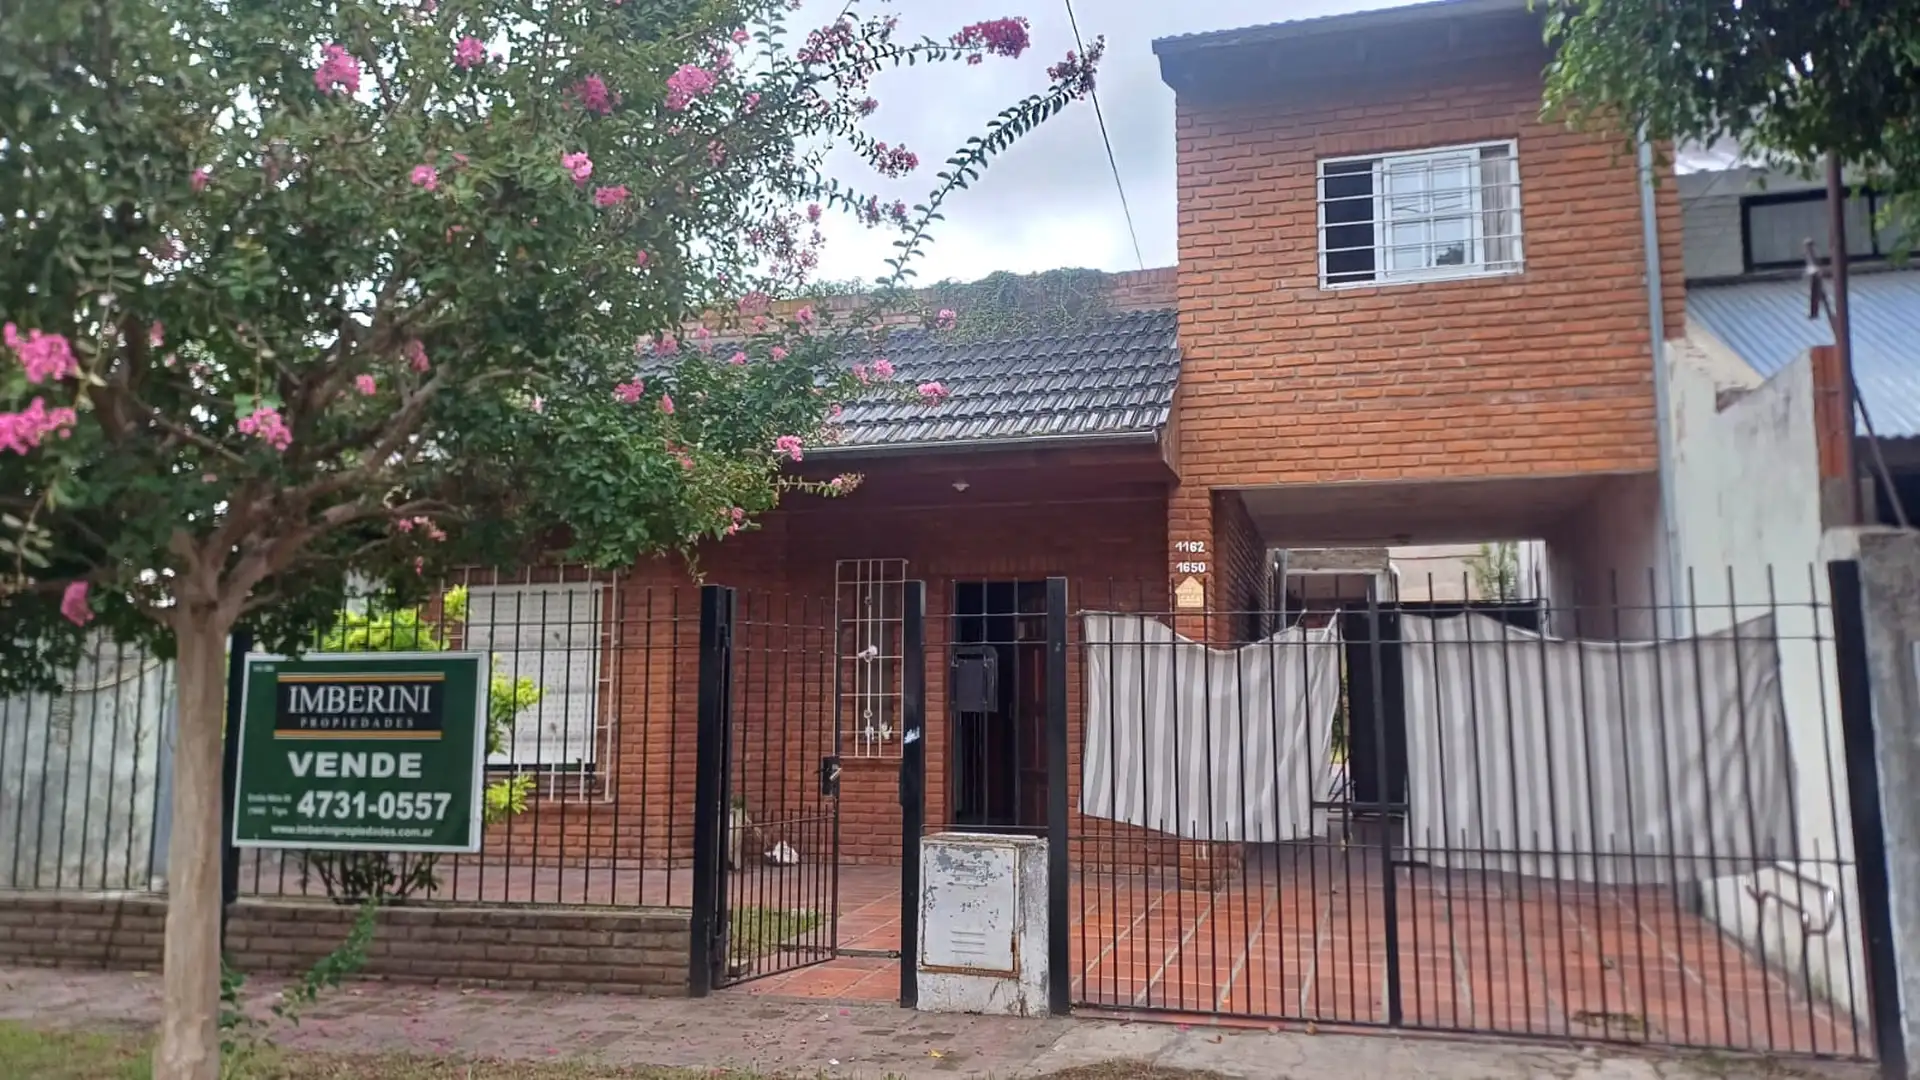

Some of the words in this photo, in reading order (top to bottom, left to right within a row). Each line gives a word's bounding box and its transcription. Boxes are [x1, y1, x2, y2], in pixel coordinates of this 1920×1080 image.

[1175, 541, 1205, 553] 1162
[1176, 562, 1206, 573] 1650
[288, 685, 431, 714] IMBERINI
[300, 717, 415, 729] PROPIEDADES
[287, 752, 422, 779] VENDE
[297, 790, 452, 820] 4731-0557
